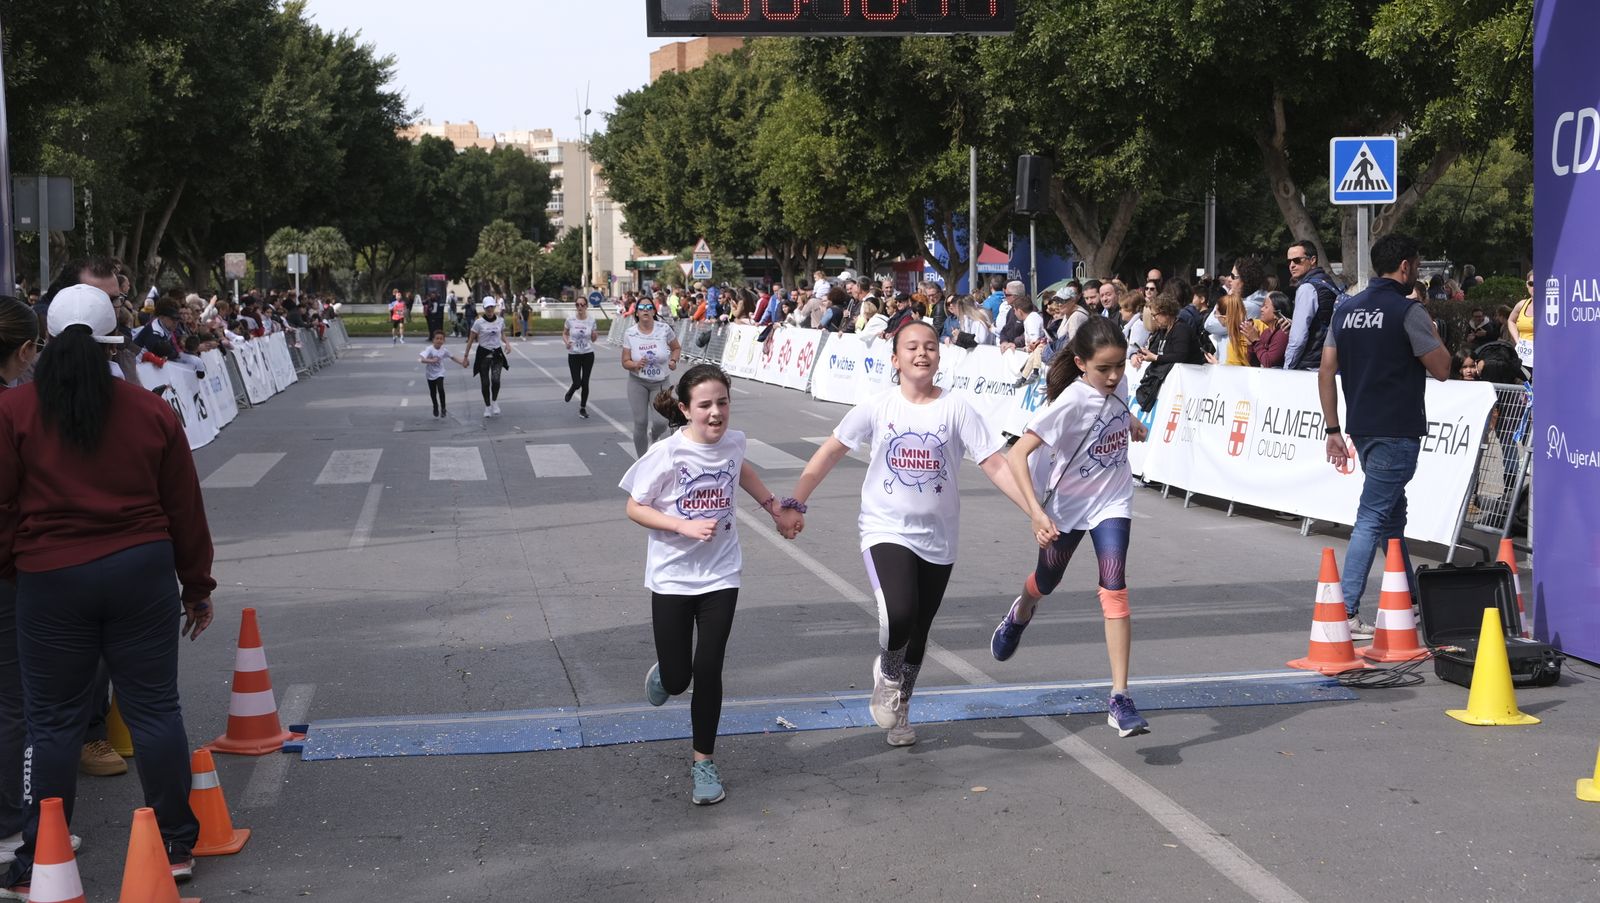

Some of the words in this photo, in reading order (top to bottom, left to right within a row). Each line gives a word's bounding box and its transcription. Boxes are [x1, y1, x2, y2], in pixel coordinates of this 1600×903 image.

[1552, 107, 1600, 176] CD
[901, 448, 930, 459] MINI
[1257, 438, 1296, 461] CIUDAD
[891, 458, 940, 469] RUNNER
[695, 488, 723, 499] MINI
[683, 498, 731, 509] RUNNER
